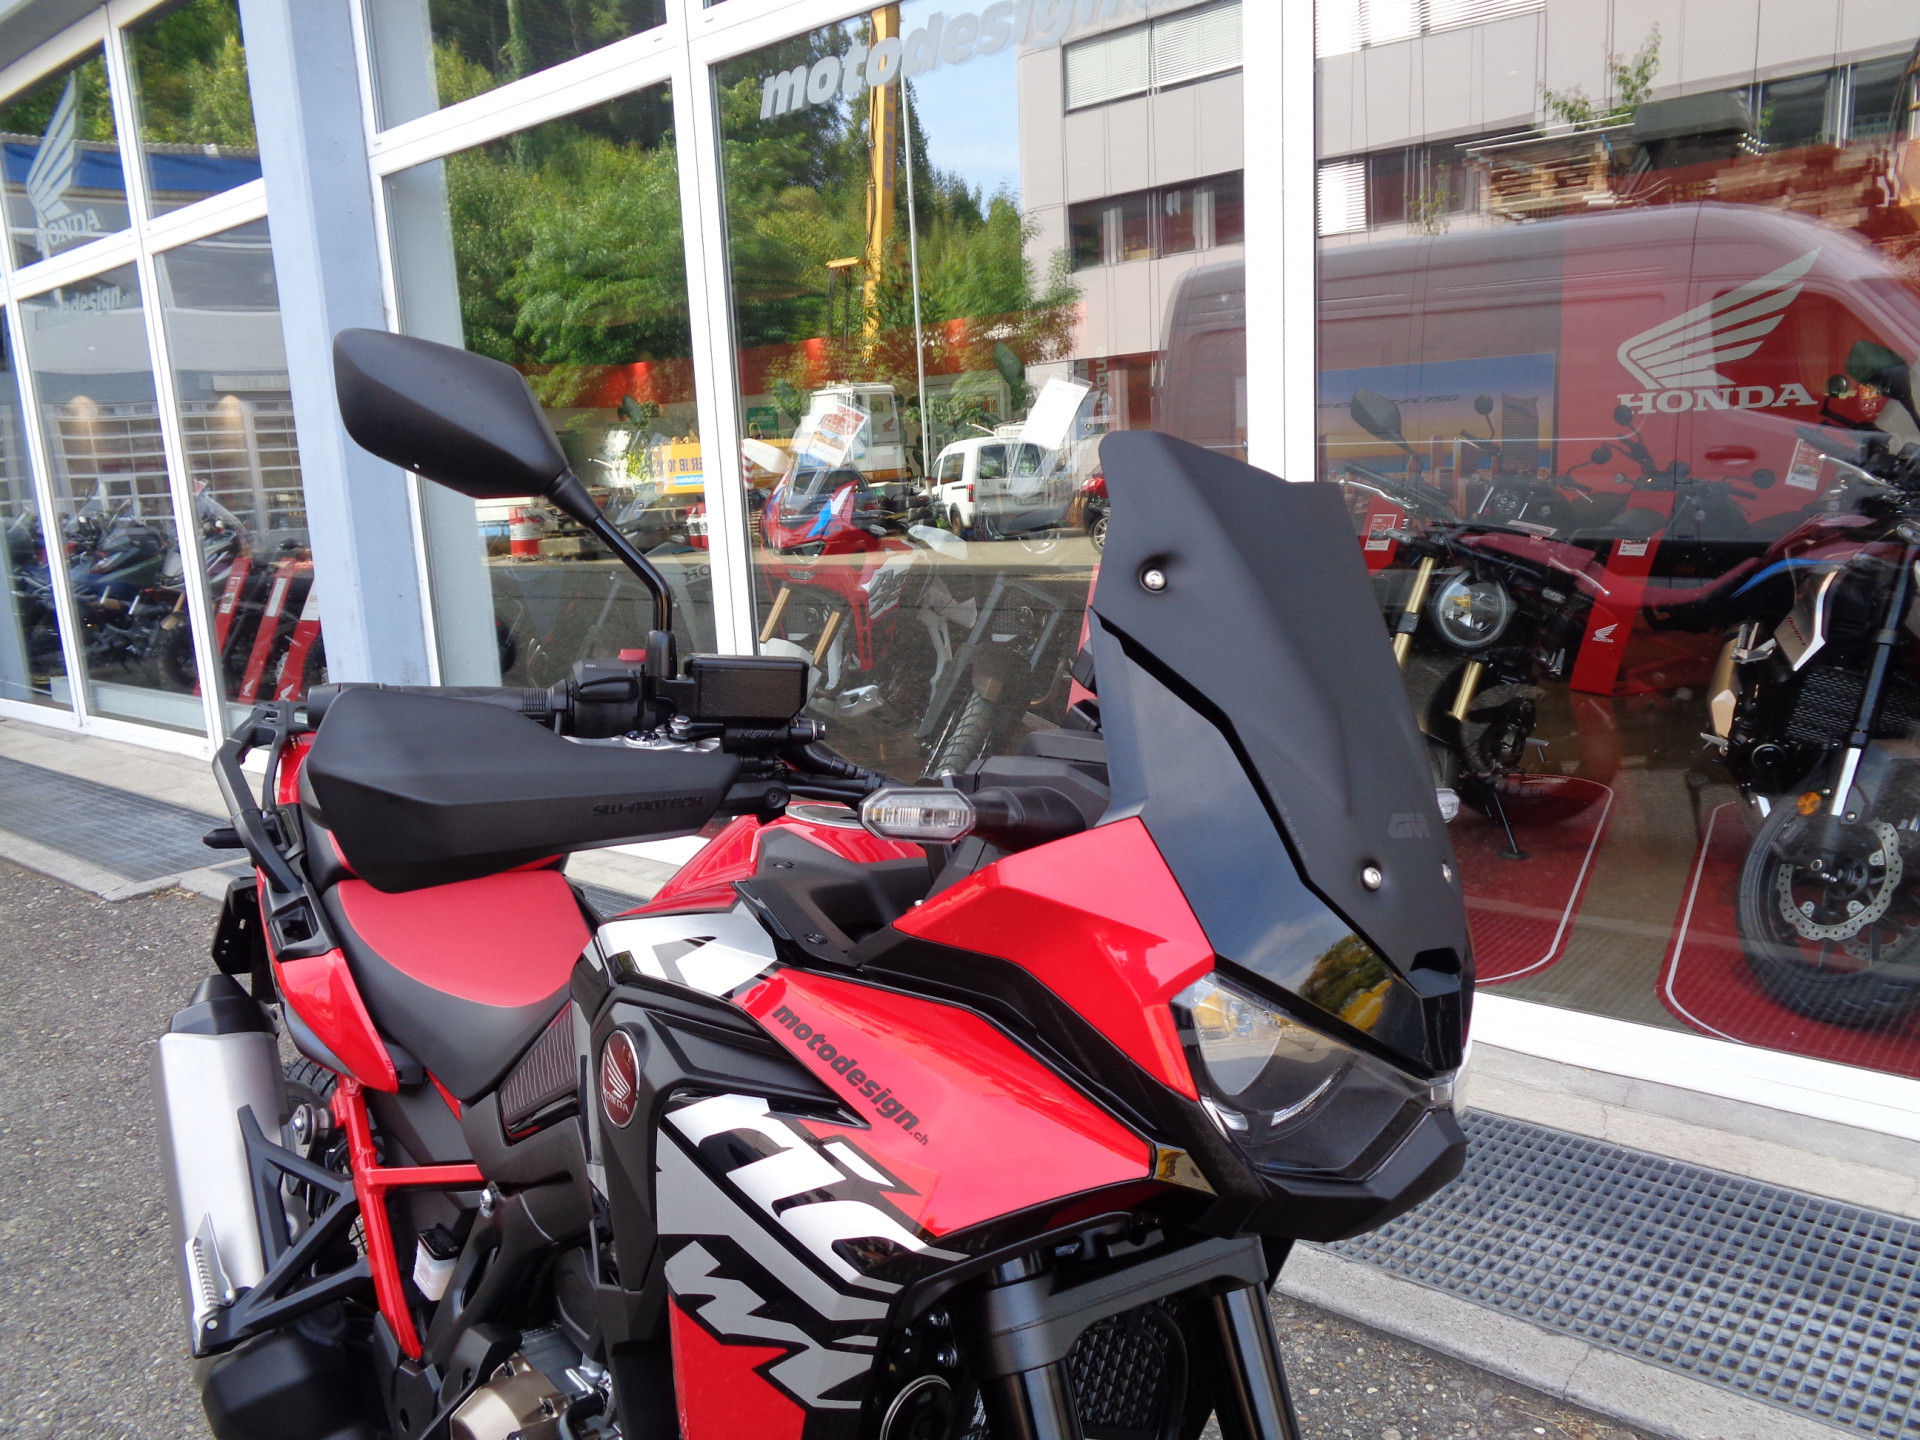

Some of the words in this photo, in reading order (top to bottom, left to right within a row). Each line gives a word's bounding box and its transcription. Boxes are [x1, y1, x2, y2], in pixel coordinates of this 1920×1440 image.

[1617, 383, 1818, 414] HONDA
[772, 1005, 929, 1146] motodesign.ch
[602, 1088, 630, 1115] HONDA
